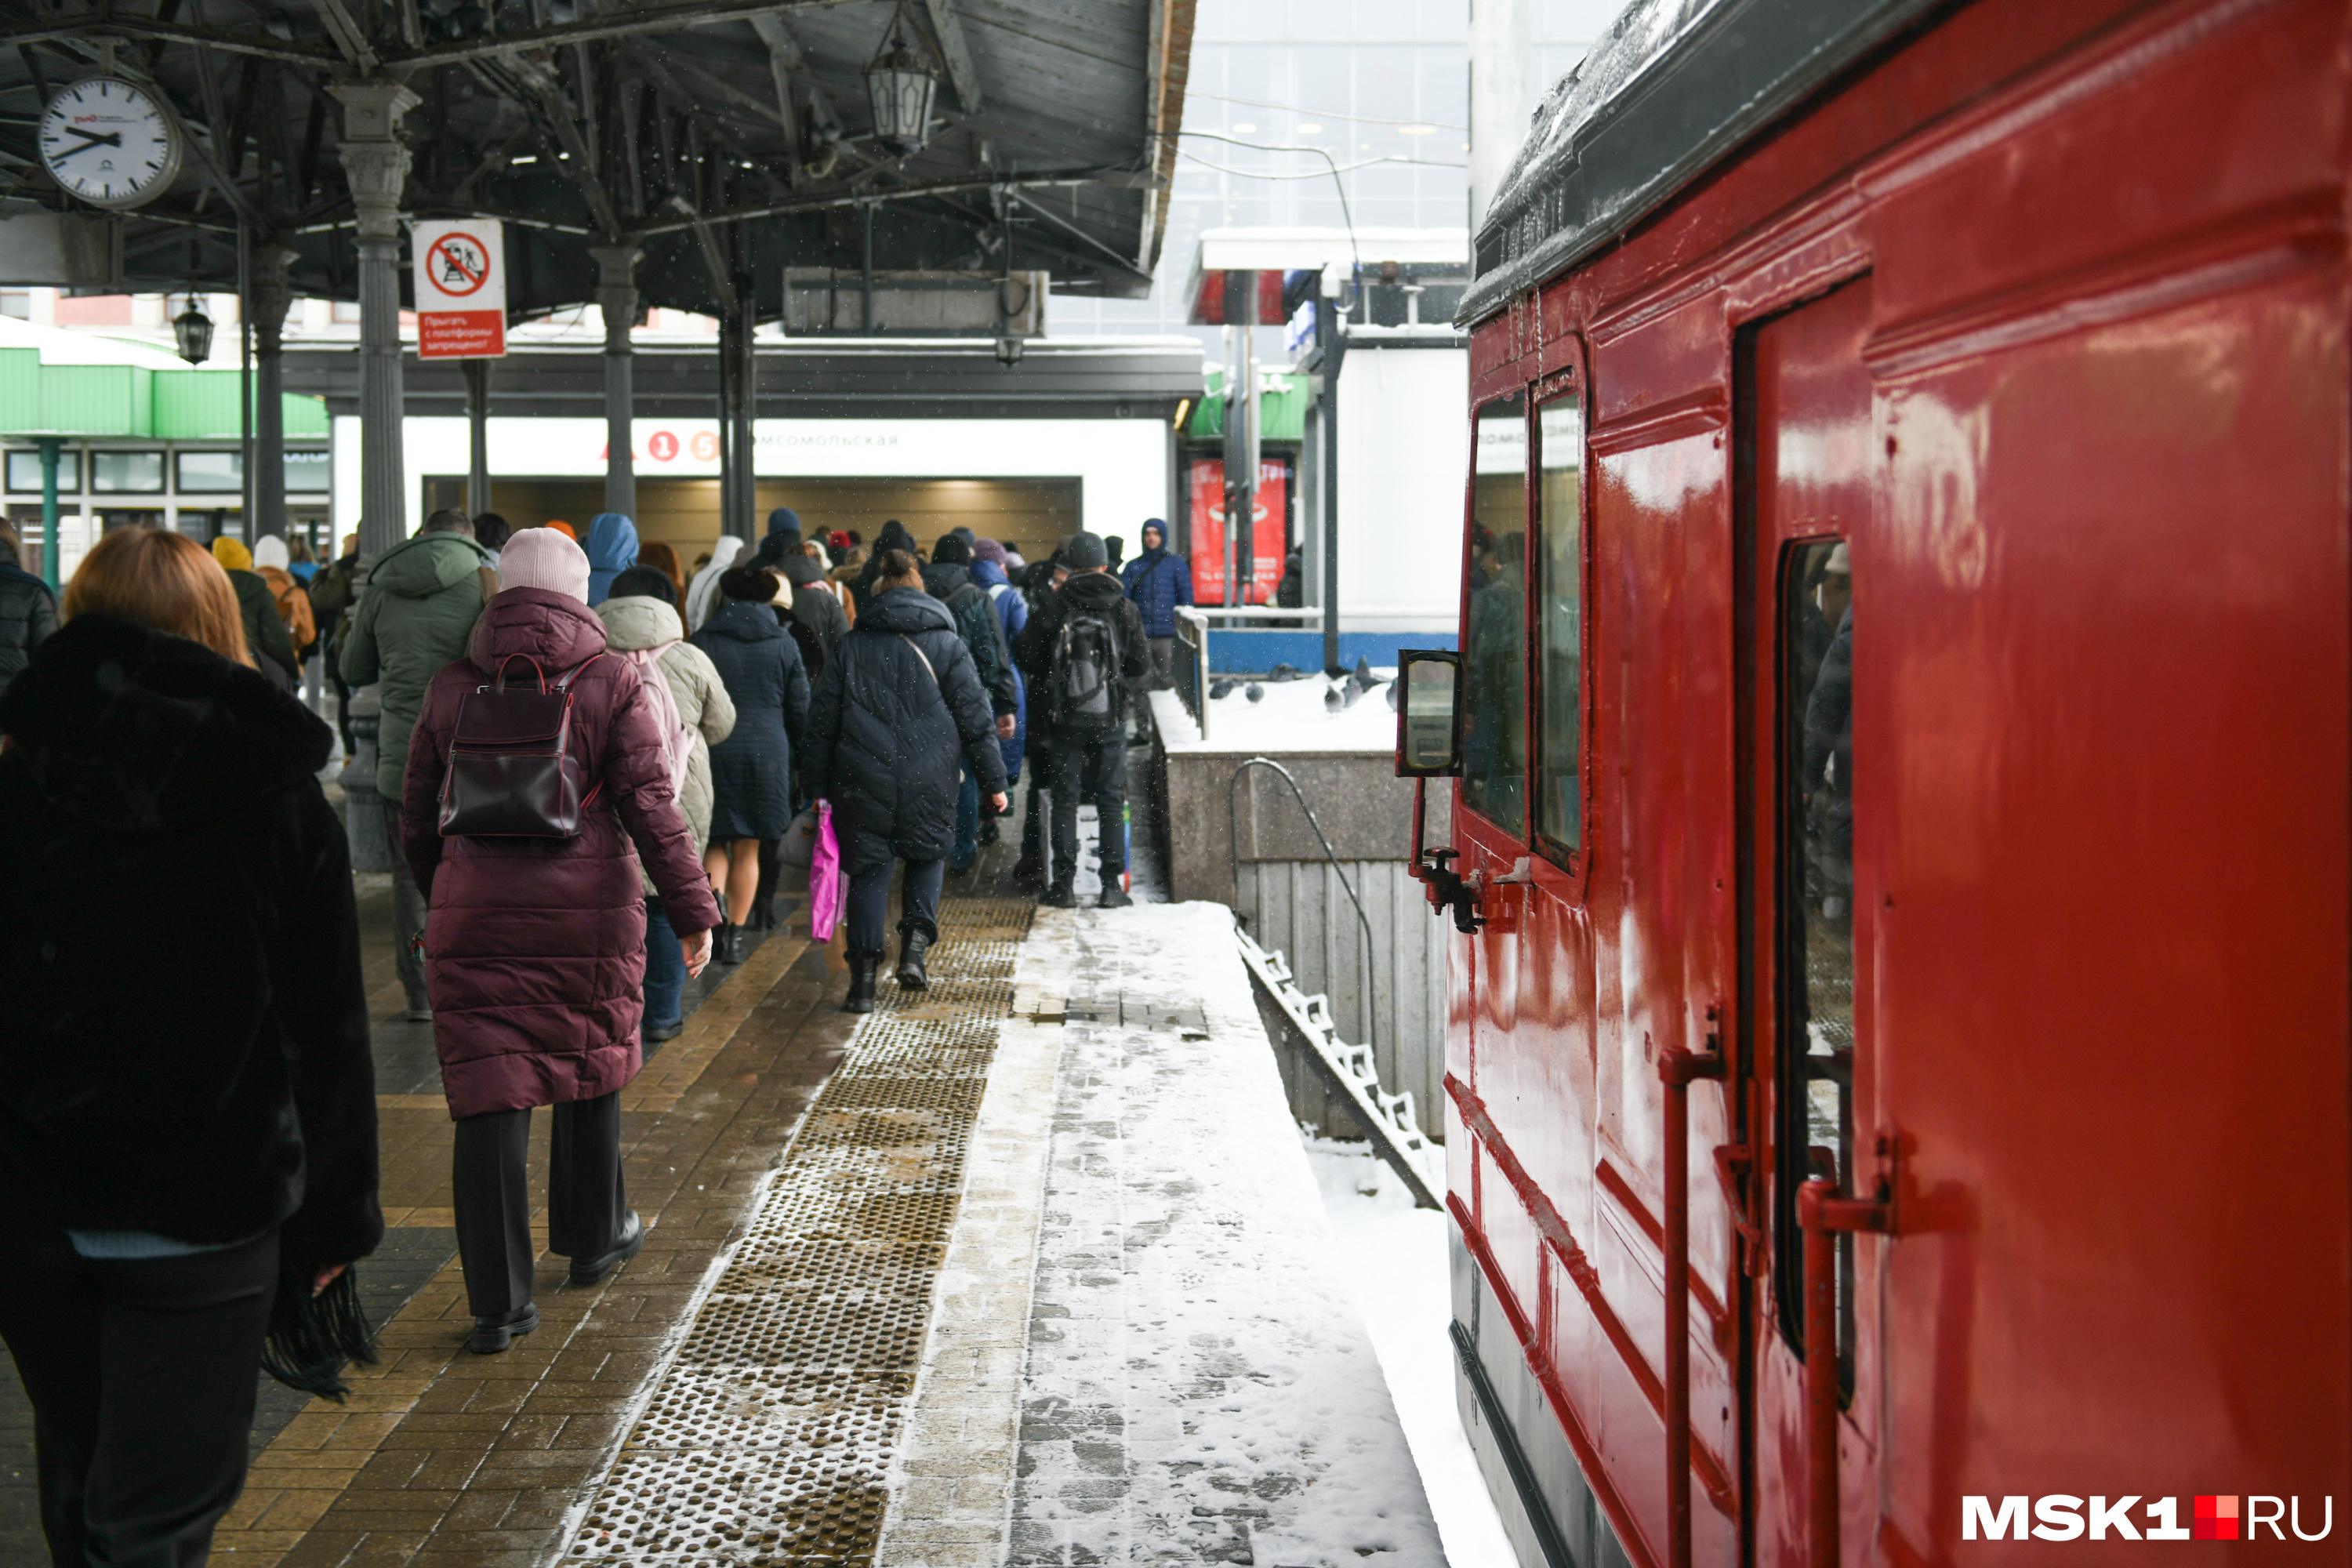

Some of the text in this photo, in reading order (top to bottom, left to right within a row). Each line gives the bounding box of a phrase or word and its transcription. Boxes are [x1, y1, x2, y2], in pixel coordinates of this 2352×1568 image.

[424, 316, 468, 327] Прыгать
[424, 328, 493, 339] с платформы
[426, 339, 488, 351] запрещено!
[753, 434, 899, 447] мсомольская
